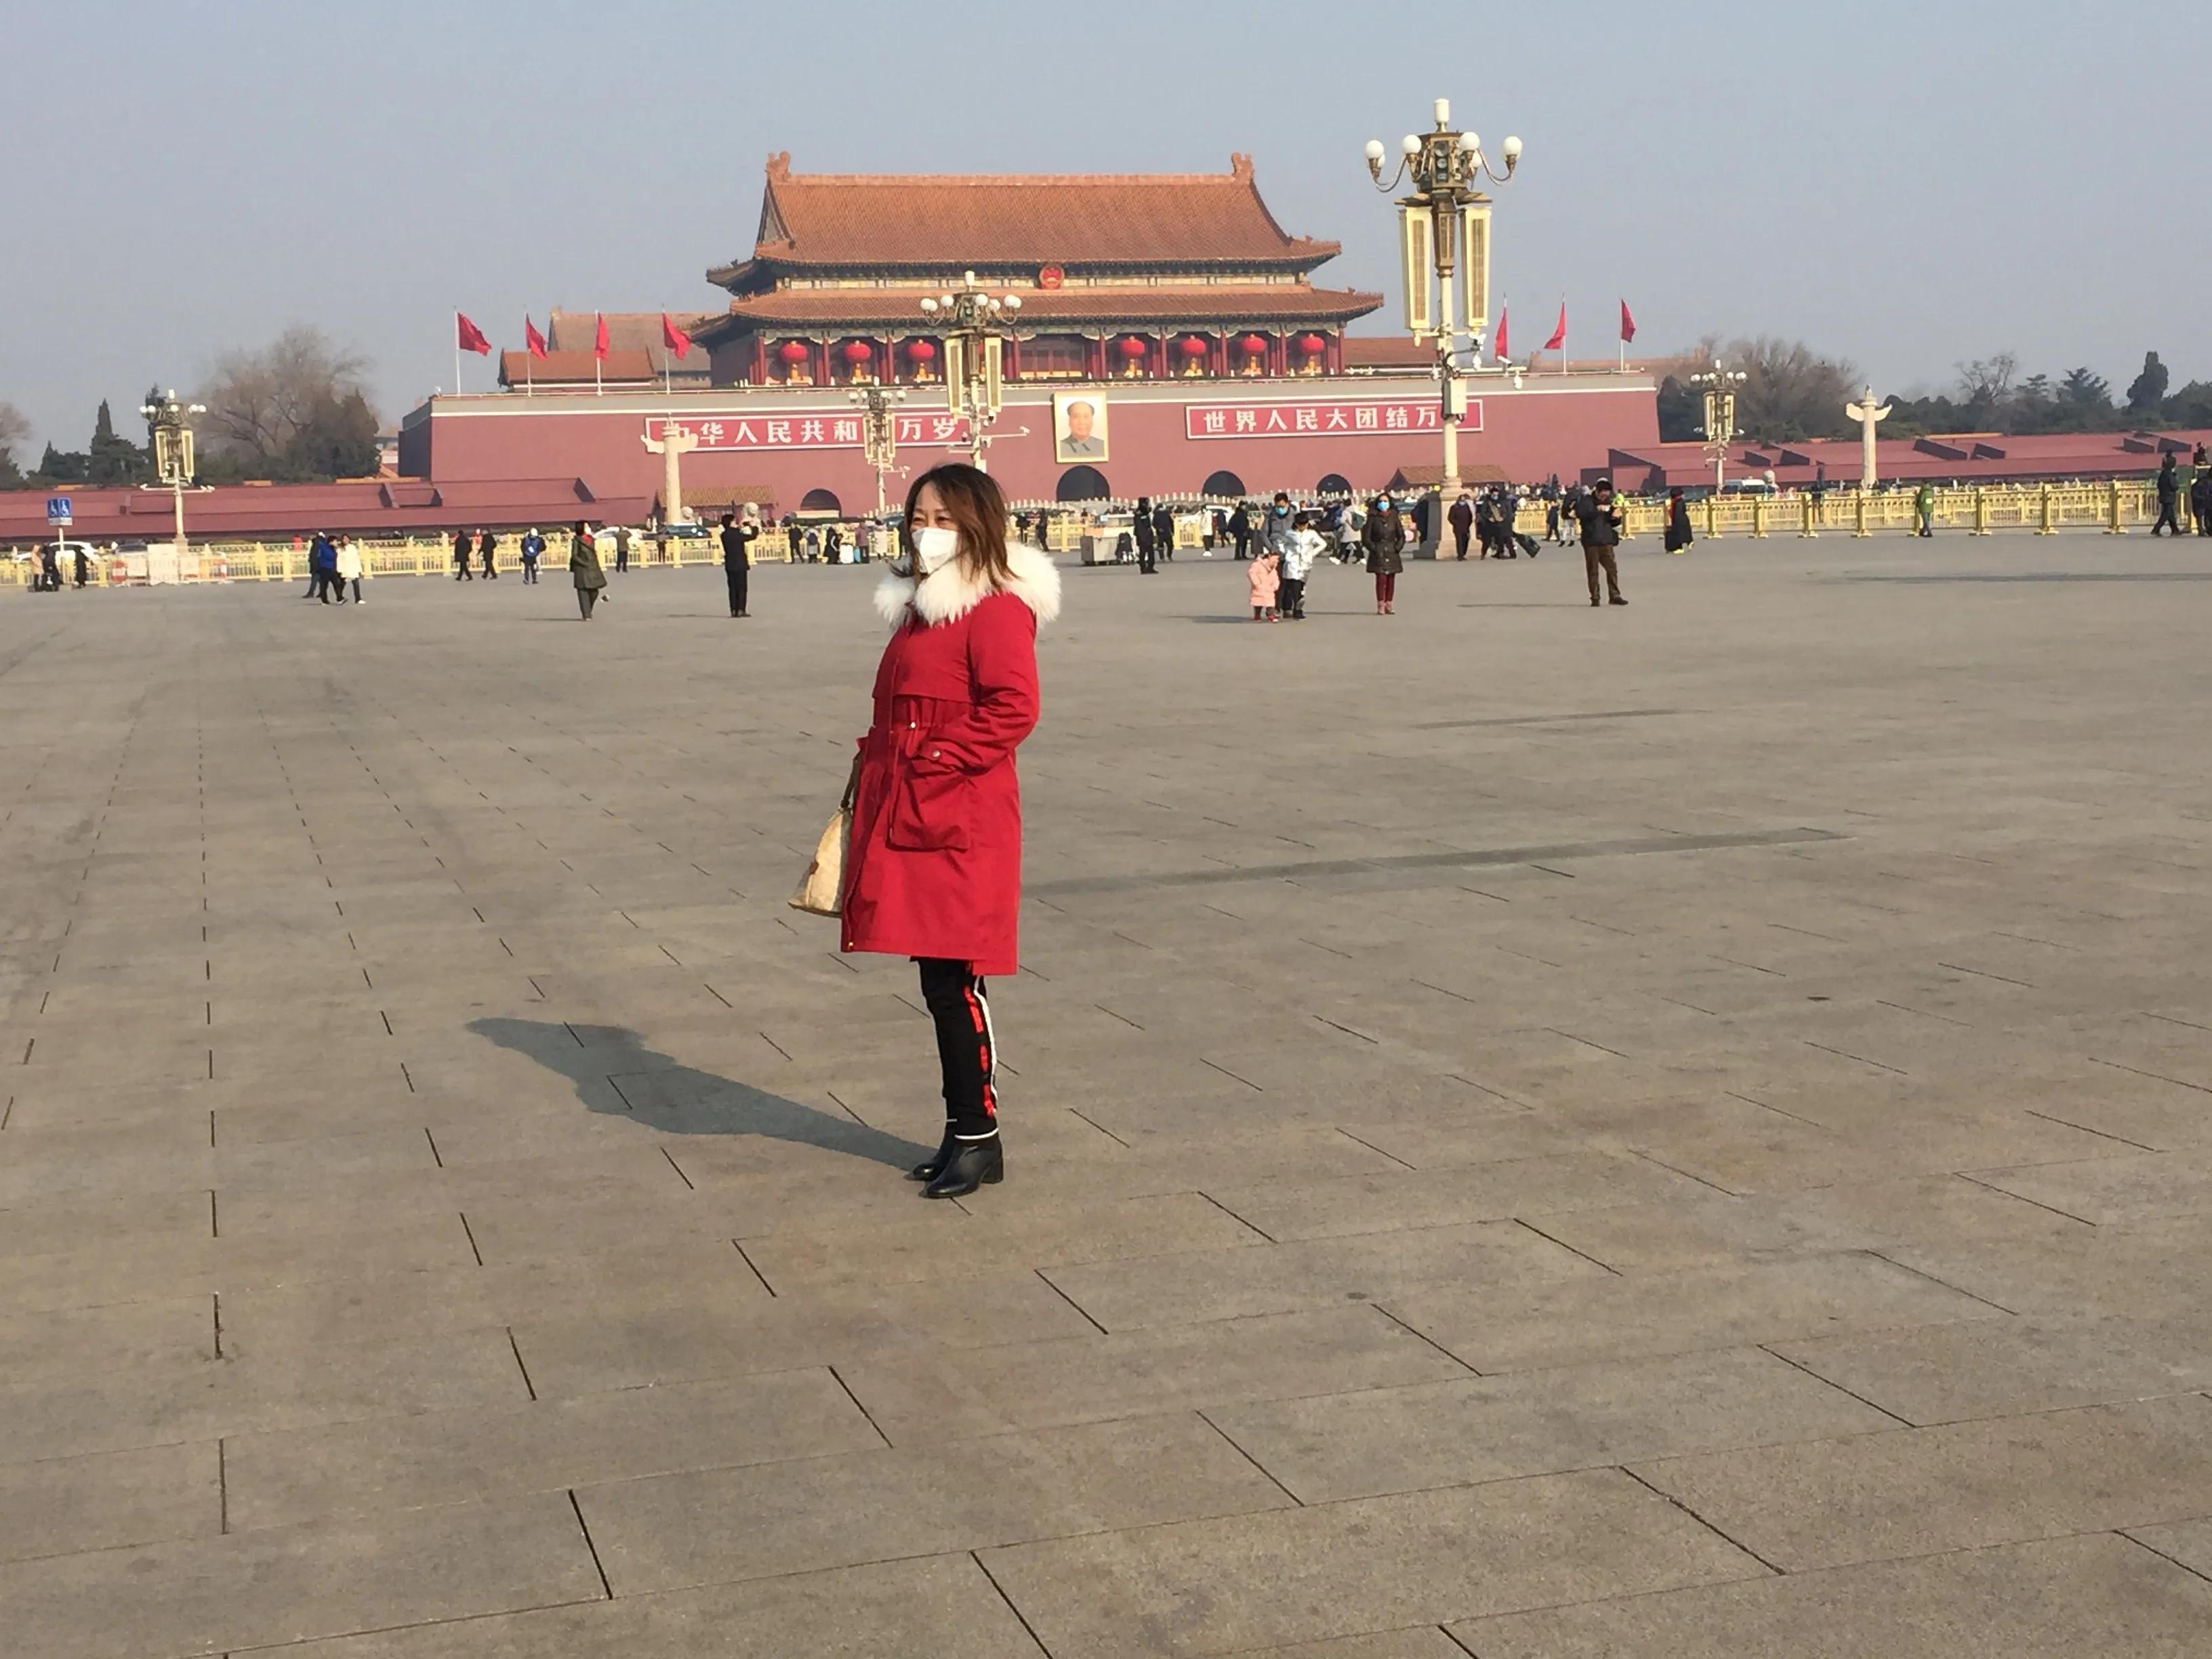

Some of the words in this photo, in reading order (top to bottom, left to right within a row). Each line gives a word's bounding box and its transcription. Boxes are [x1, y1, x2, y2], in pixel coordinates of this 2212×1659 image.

[679, 417, 956, 445] 华人民共和万岁
[1204, 406, 1437, 433] 世界人民大团结万
